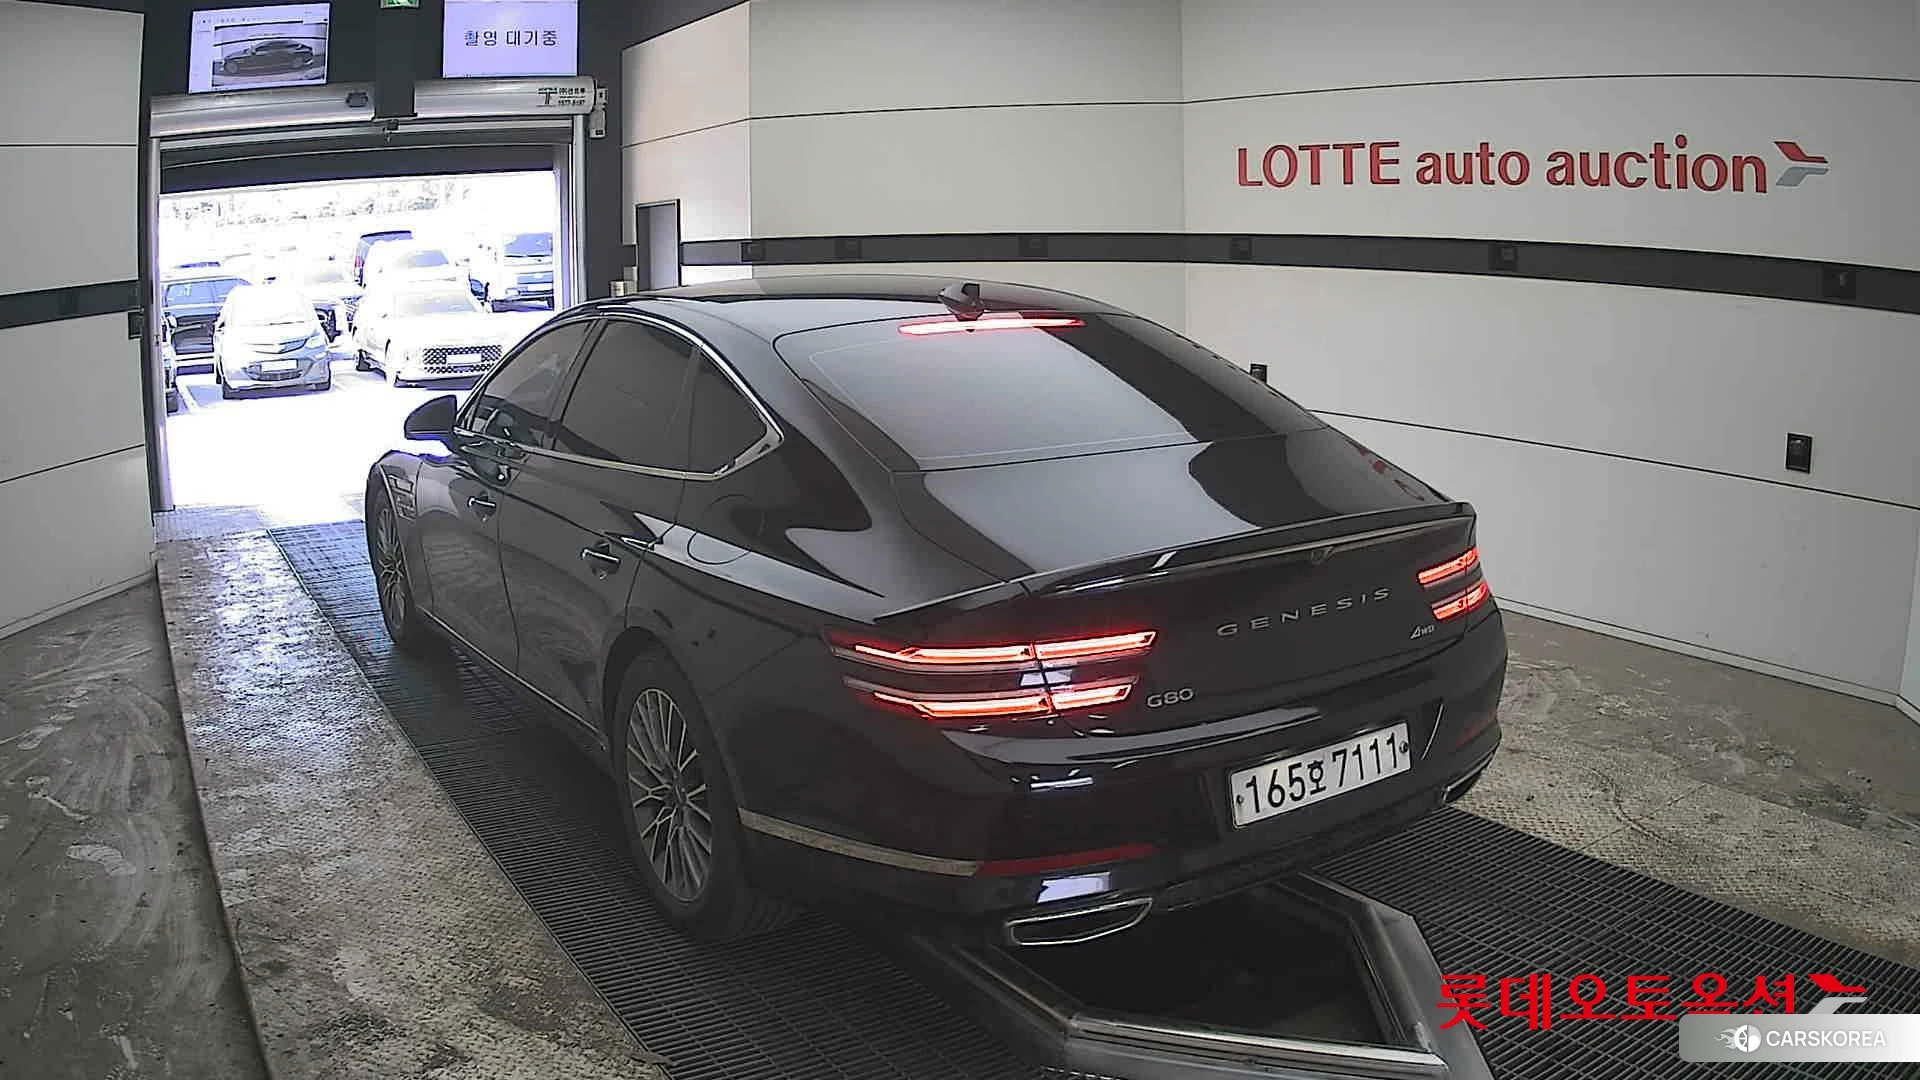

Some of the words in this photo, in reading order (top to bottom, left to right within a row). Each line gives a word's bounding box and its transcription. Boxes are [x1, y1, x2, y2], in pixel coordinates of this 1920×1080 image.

[506, 30, 557, 46] 대기중
[1238, 141, 1401, 188] LOTTE
[1416, 142, 1530, 186] auto
[1546, 134, 1768, 193] auction
[1216, 587, 1391, 636] GENESIS
[1147, 688, 1194, 708] G80
[1246, 760, 1327, 813] 165호
[1332, 732, 1397, 788] 7111
